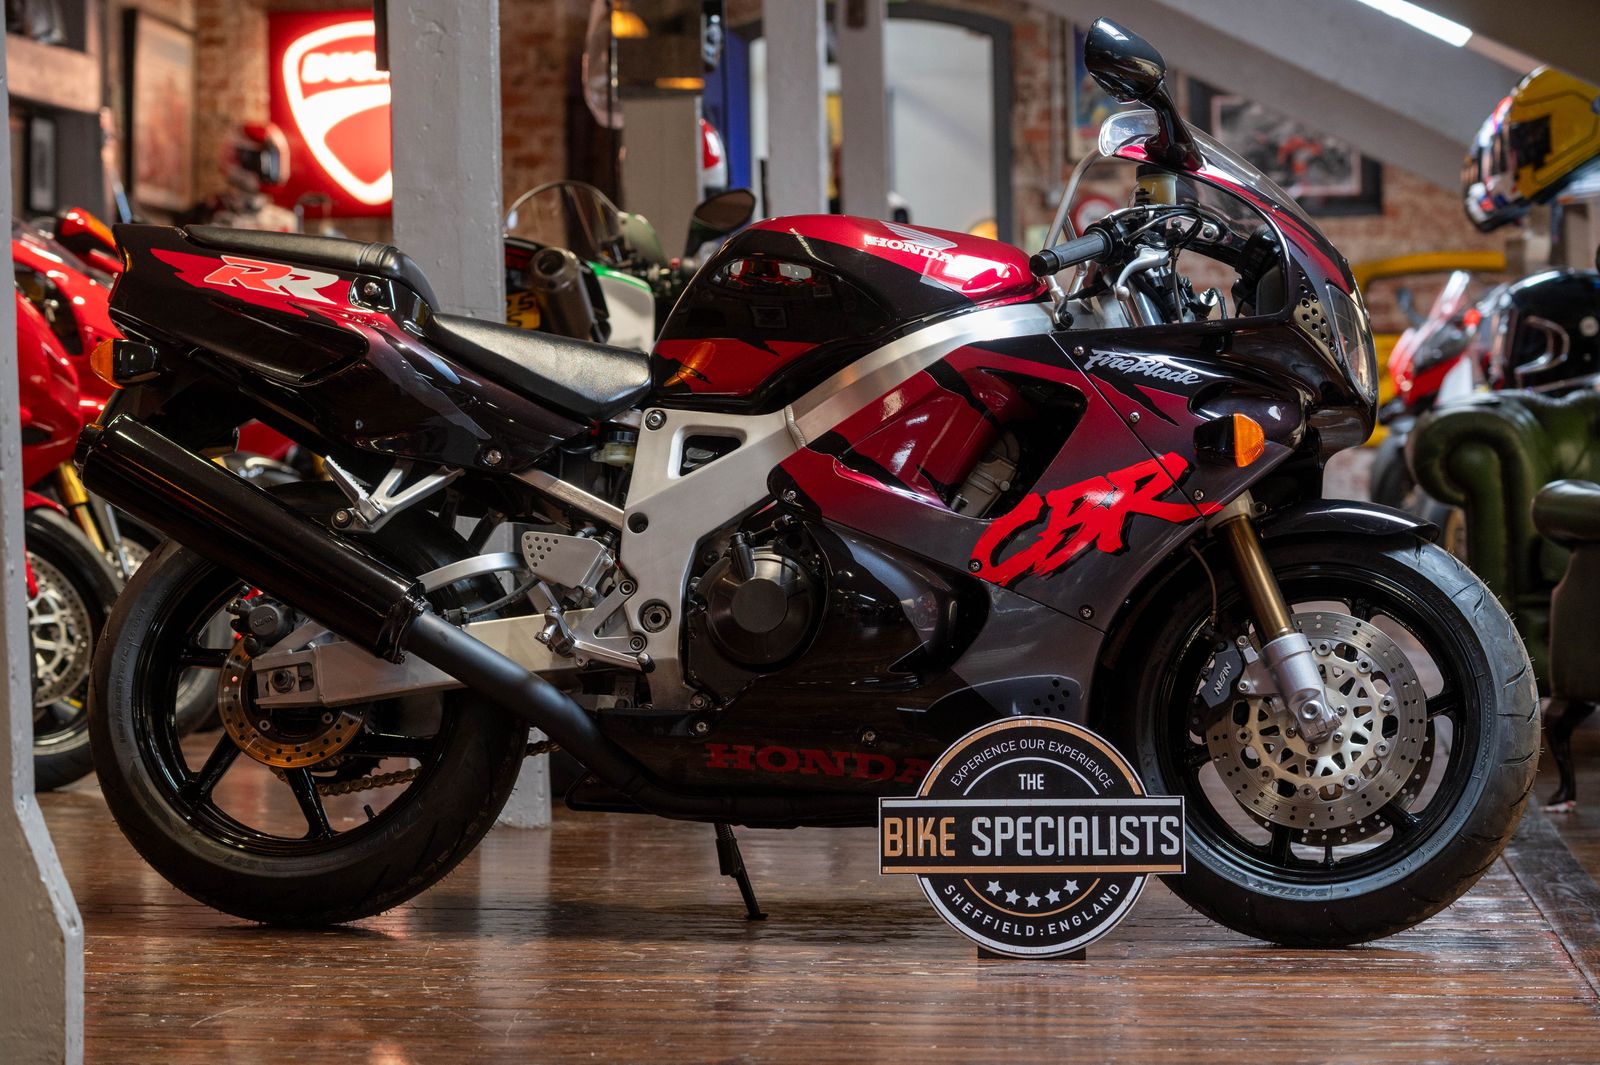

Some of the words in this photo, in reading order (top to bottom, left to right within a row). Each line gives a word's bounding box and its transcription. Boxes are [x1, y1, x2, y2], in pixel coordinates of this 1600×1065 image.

[863, 233, 957, 262] HONDA
[203, 254, 340, 305] RR
[969, 451, 1226, 588] CBR
[950, 740, 1017, 787] EXPERIENCE
[1019, 738, 1046, 751] OUR
[1048, 740, 1115, 789] EXPERIENCE
[1018, 773, 1045, 791] THE
[883, 816, 956, 857] BIKE
[971, 815, 1180, 857] SPECIALISTS
